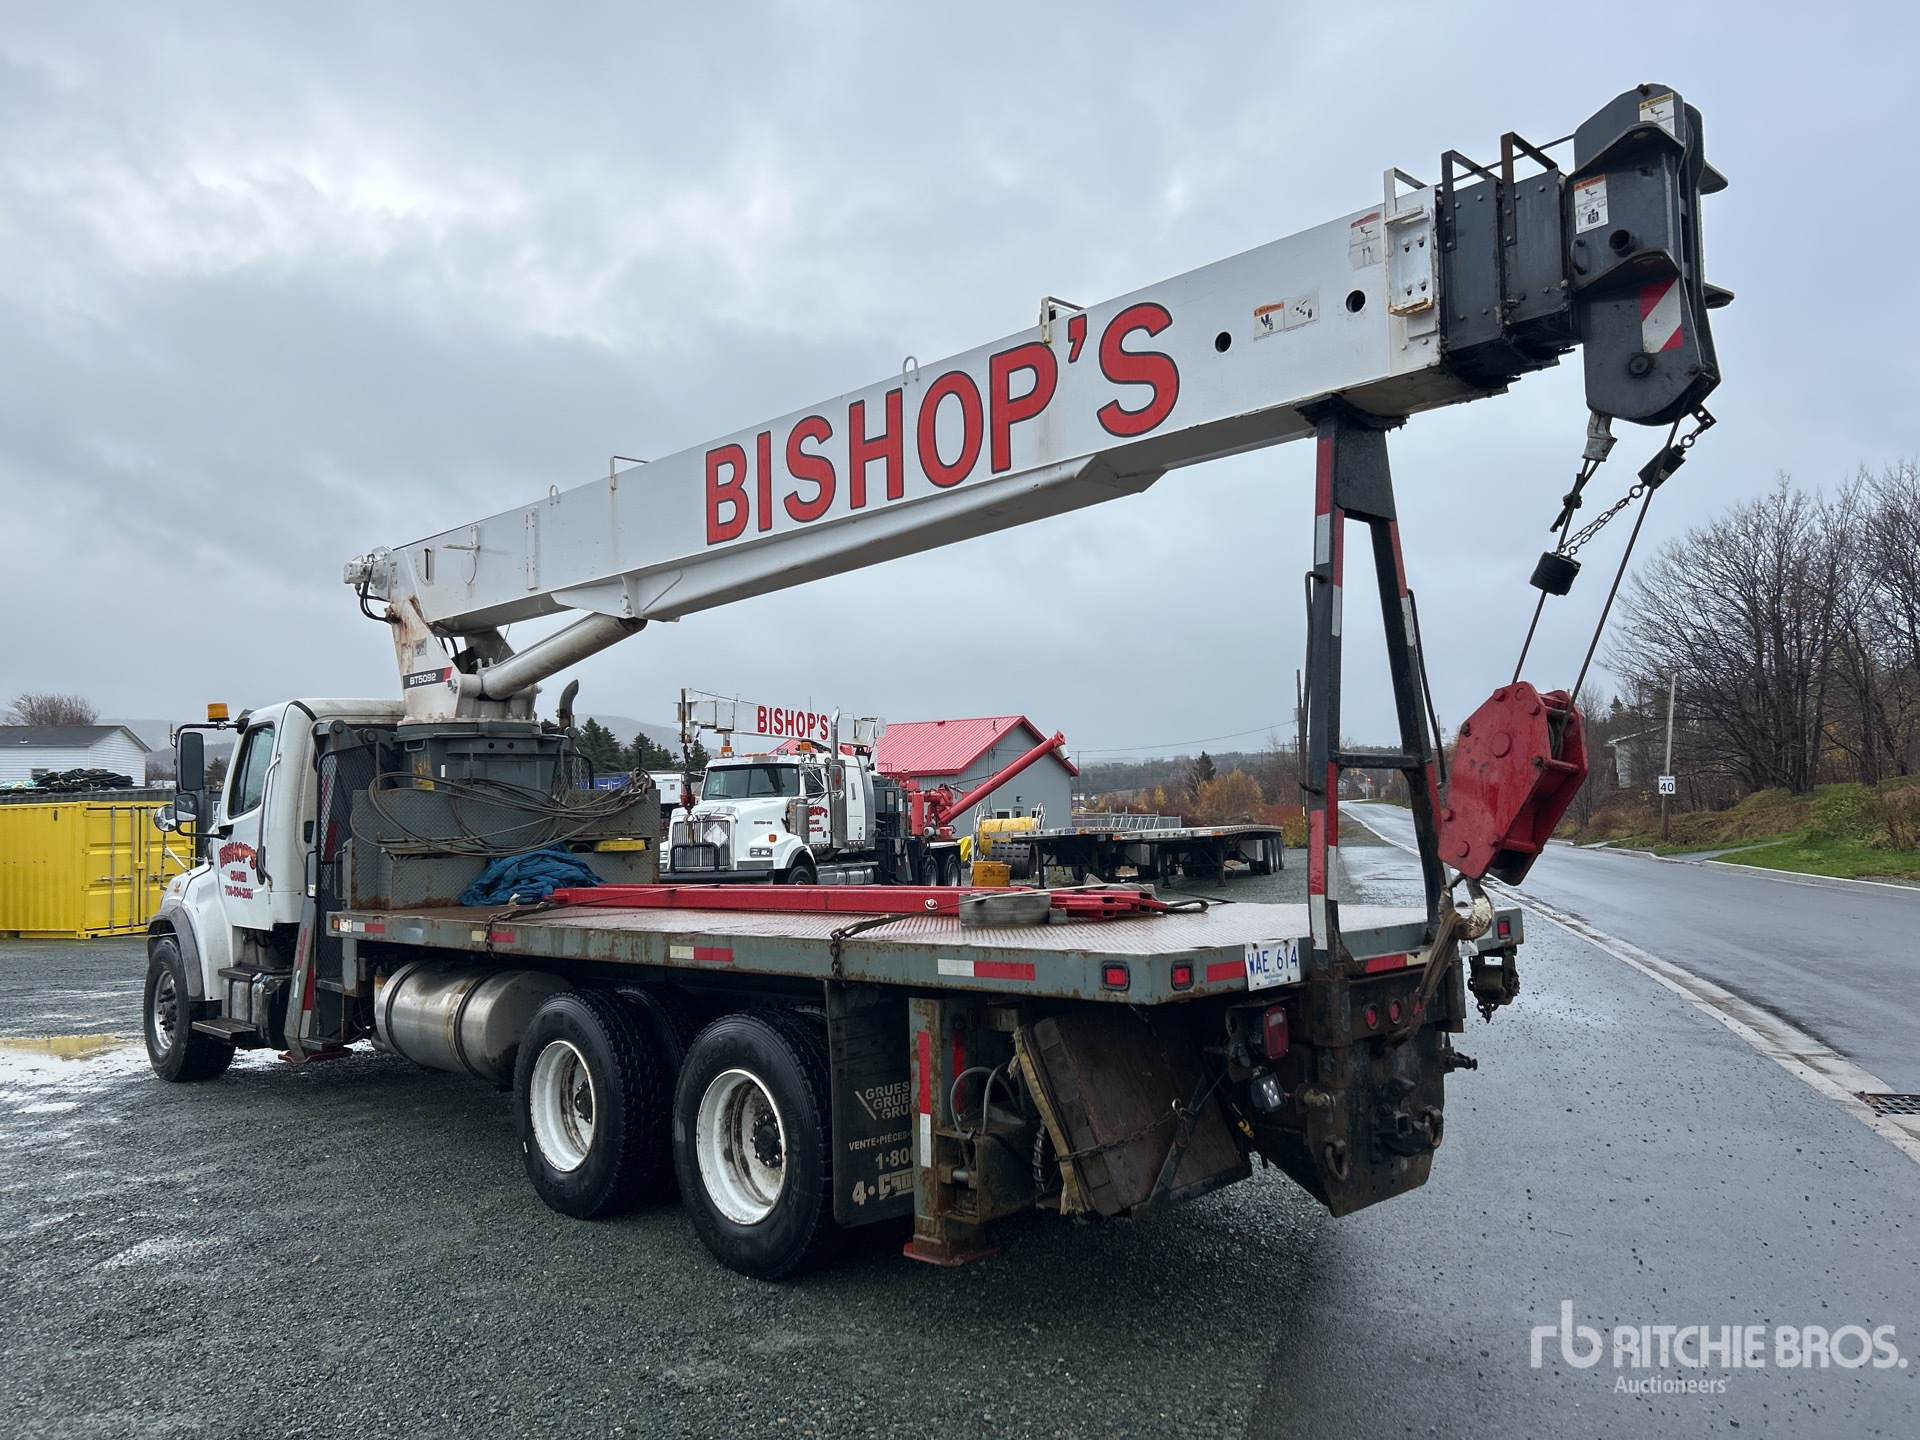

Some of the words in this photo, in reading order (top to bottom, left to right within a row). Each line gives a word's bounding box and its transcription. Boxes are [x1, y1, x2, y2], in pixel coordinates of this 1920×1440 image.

[1646, 94, 1673, 107] WARNING
[705, 302, 1180, 546] BISHOP'S
[409, 672, 437, 686] BT5092
[757, 705, 829, 741] BISHOP'S
[1660, 782, 1674, 792] 40
[219, 842, 258, 870] BISHOP'S
[1247, 950, 1270, 975] WAE
[1276, 946, 1298, 970] 614
[865, 1081, 910, 1100] GRUES
